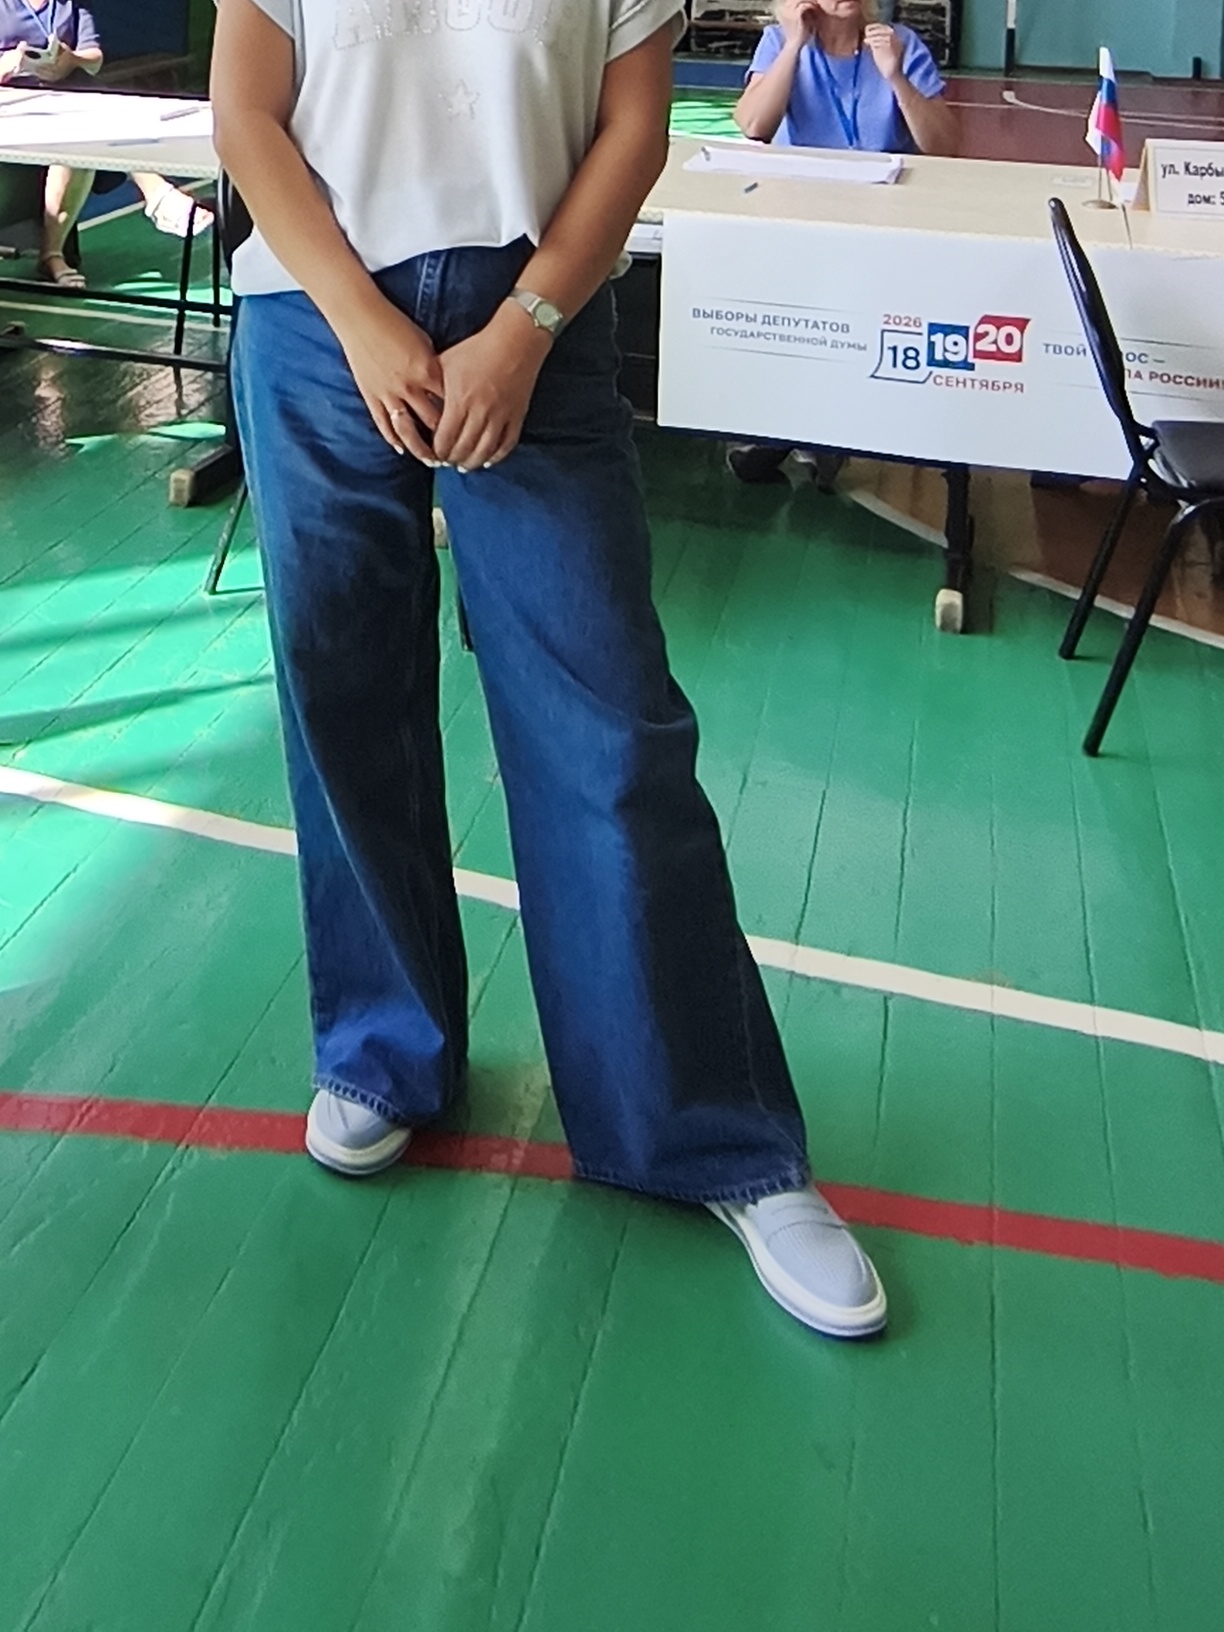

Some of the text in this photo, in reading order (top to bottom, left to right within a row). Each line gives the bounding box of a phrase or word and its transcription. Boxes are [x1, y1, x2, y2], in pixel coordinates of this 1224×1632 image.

[692, 307, 851, 334] ВЫБОРЫ ДЕПУТАТОВ
[883, 314, 922, 328] 2026
[710, 326, 868, 352] ГОСУДАРСТВЕННОЙ ДУМЫ
[887, 323, 1022, 371] 18 19 20
[1043, 342, 1087, 357] ТВОЙ
[932, 374, 1025, 394] СЕНТЯБРЯ
